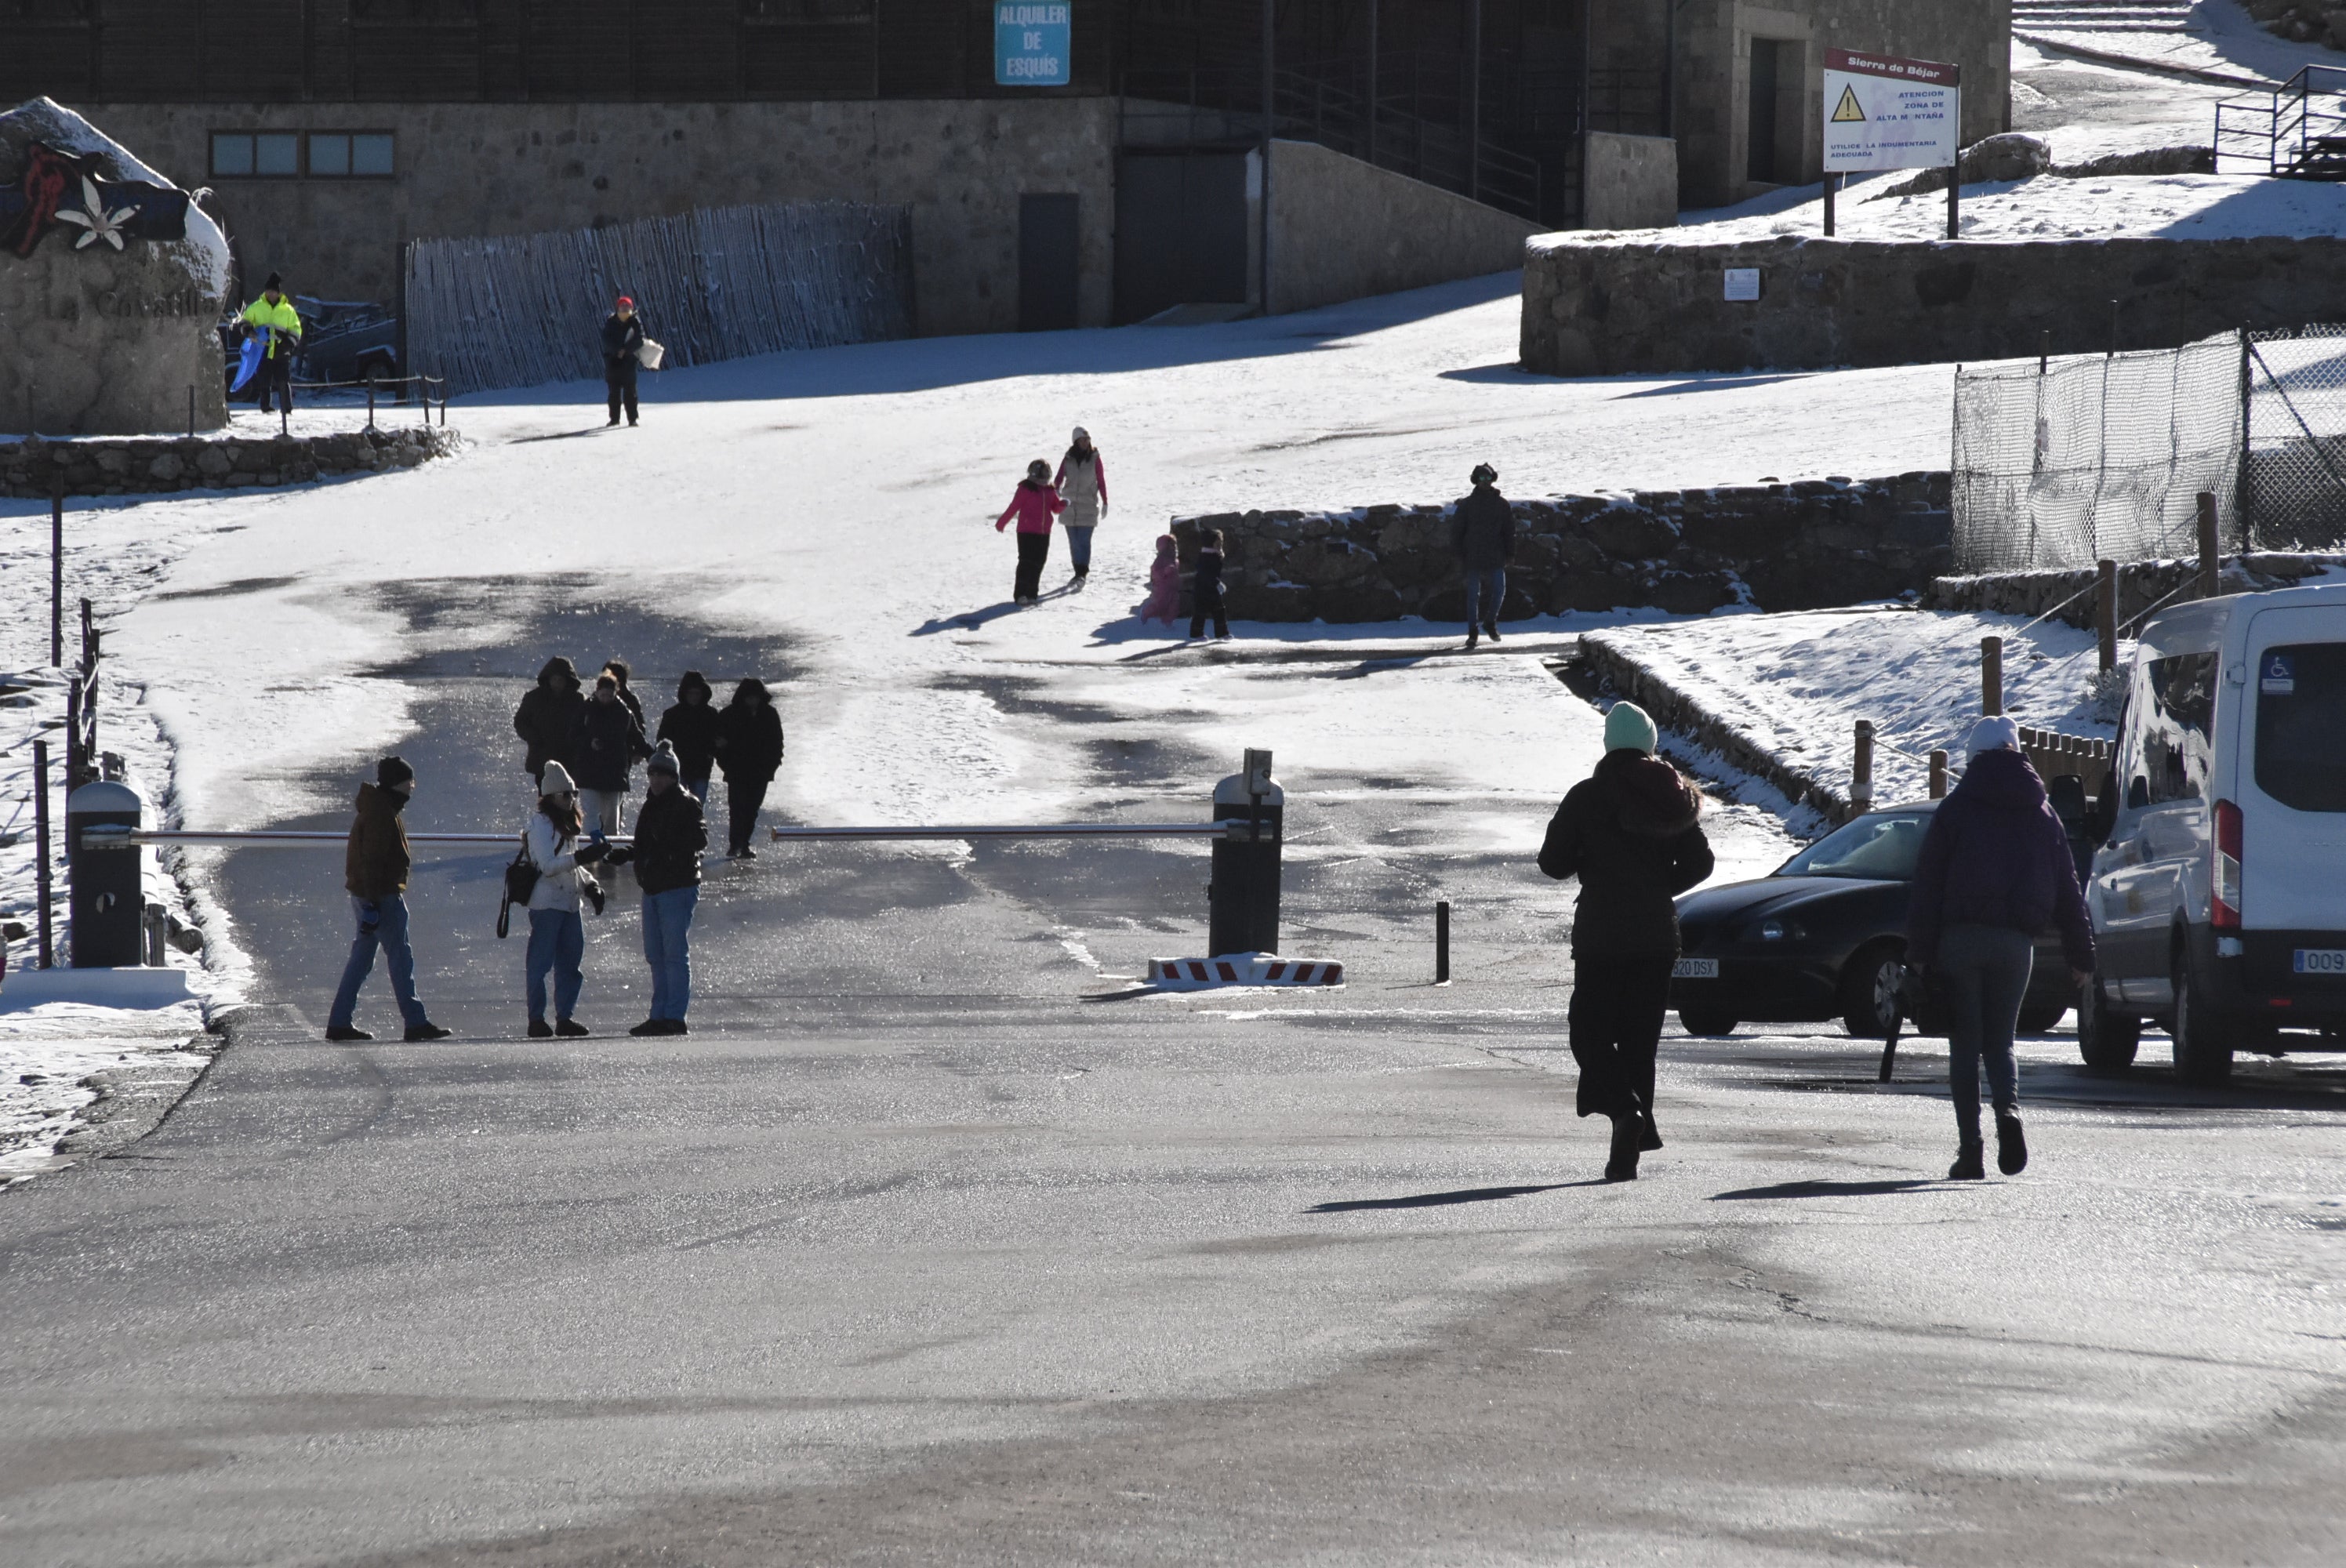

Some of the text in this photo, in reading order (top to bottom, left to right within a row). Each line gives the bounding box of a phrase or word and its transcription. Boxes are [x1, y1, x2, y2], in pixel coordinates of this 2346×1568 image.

[999, 5, 1066, 27] ALQUILER
[1023, 32, 1041, 49] DE
[1006, 53, 1059, 78] ESQUÍS
[1847, 56, 1940, 78] Sierra de Béjar
[1898, 90, 1945, 99] ATENCION
[1900, 111, 1945, 121] MNTAÑA
[1694, 960, 1714, 975] DSX
